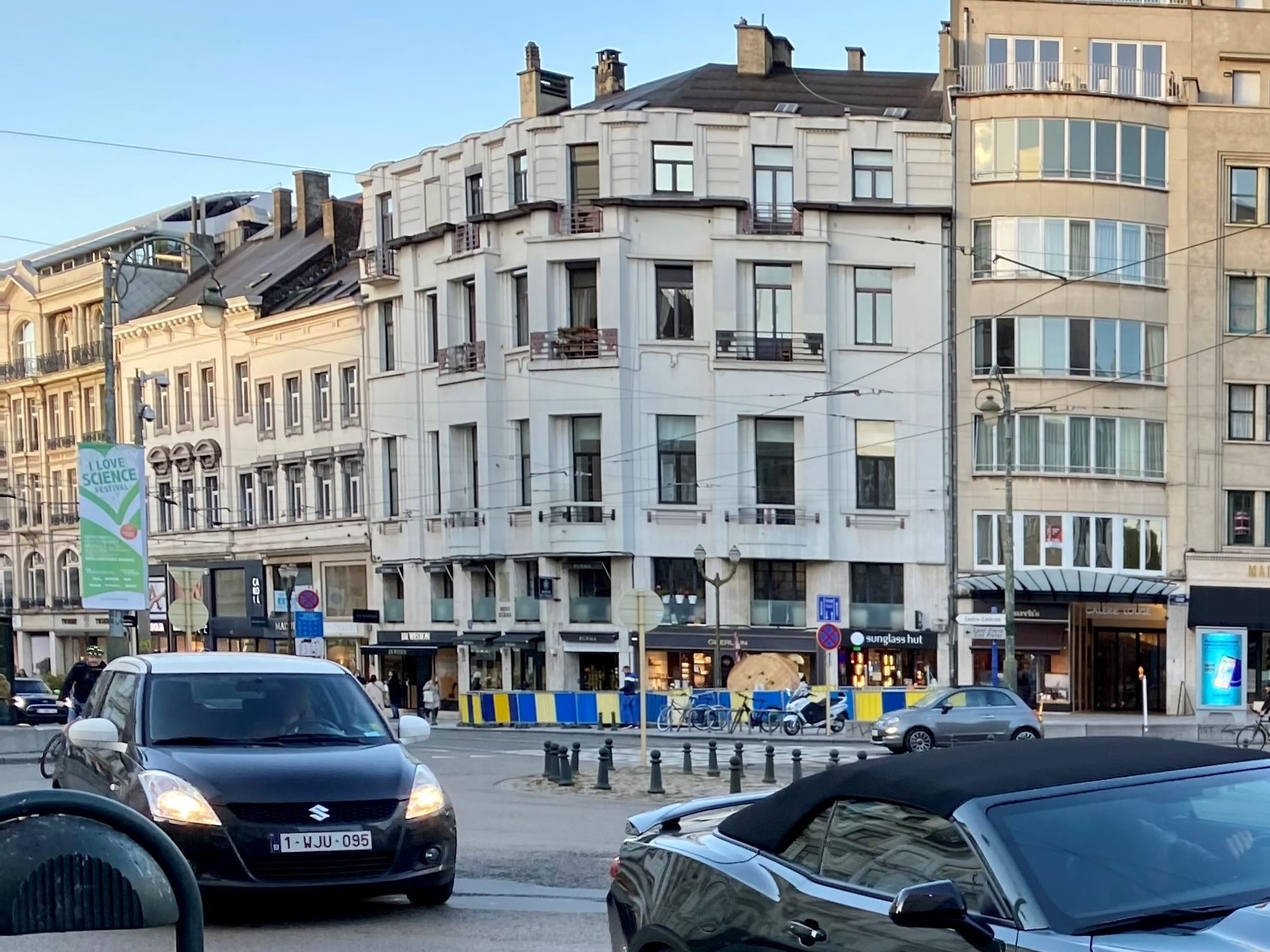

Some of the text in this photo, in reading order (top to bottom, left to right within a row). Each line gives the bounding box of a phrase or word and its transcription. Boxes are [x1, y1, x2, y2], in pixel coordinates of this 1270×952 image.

[88, 458, 126, 472] I LOVE
[82, 468, 137, 486] SCIENCE
[866, 633, 923, 646] sunglass hut
